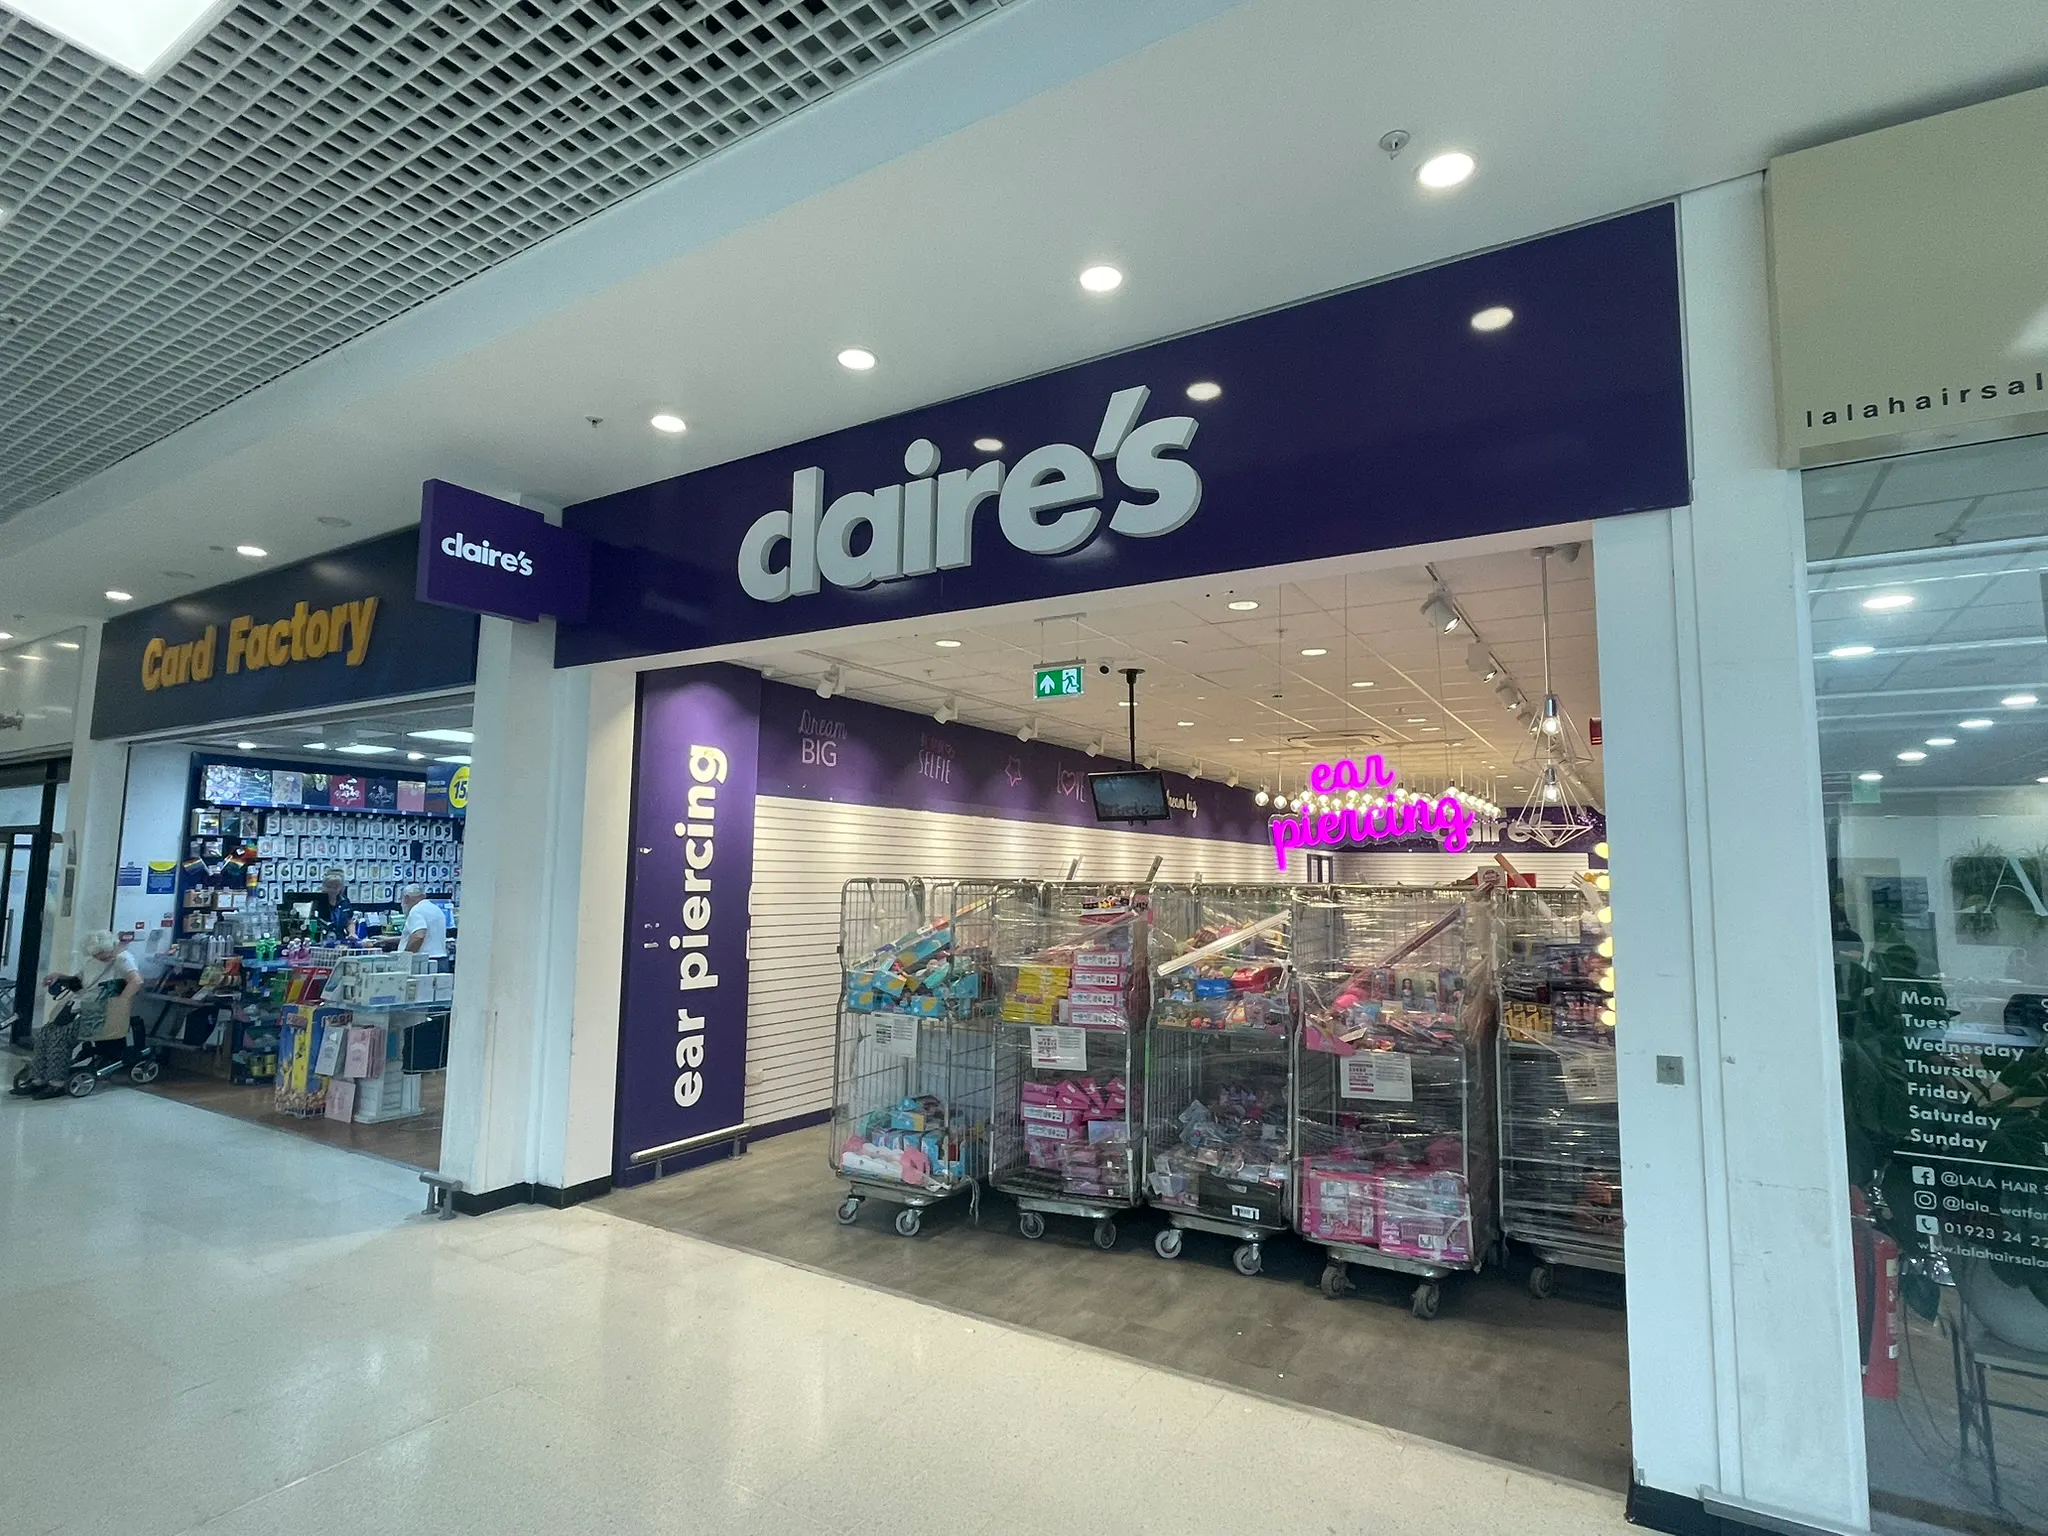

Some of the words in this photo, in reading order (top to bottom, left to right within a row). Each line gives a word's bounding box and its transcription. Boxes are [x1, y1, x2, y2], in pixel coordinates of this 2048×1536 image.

[1806, 372, 2044, 428] lalahairsal
[737, 384, 1203, 603] claire's
[441, 532, 534, 576] claire's
[141, 624, 218, 692] Card
[225, 595, 380, 676] Factory
[798, 708, 848, 740] Dream
[801, 737, 837, 768] BIG
[918, 749, 951, 785] SELFIE
[1310, 753, 1396, 793] ear
[1271, 793, 1477, 873] piercing
[669, 743, 728, 991] piercing
[673, 1008, 708, 1109] ear
[1903, 1036, 2025, 1061] Wednesday
[1905, 1059, 2001, 1083] Thursday
[1907, 1082, 1972, 1105] Friday
[1909, 1105, 2001, 1131] Saturday
[1910, 1128, 1988, 1153] Sunday
[1941, 1171, 1997, 1190] @LALA
[2001, 1180, 2039, 1195] HAIR
[1944, 1222, 1996, 1240] 01923
[2002, 1230, 2022, 1243] 24
